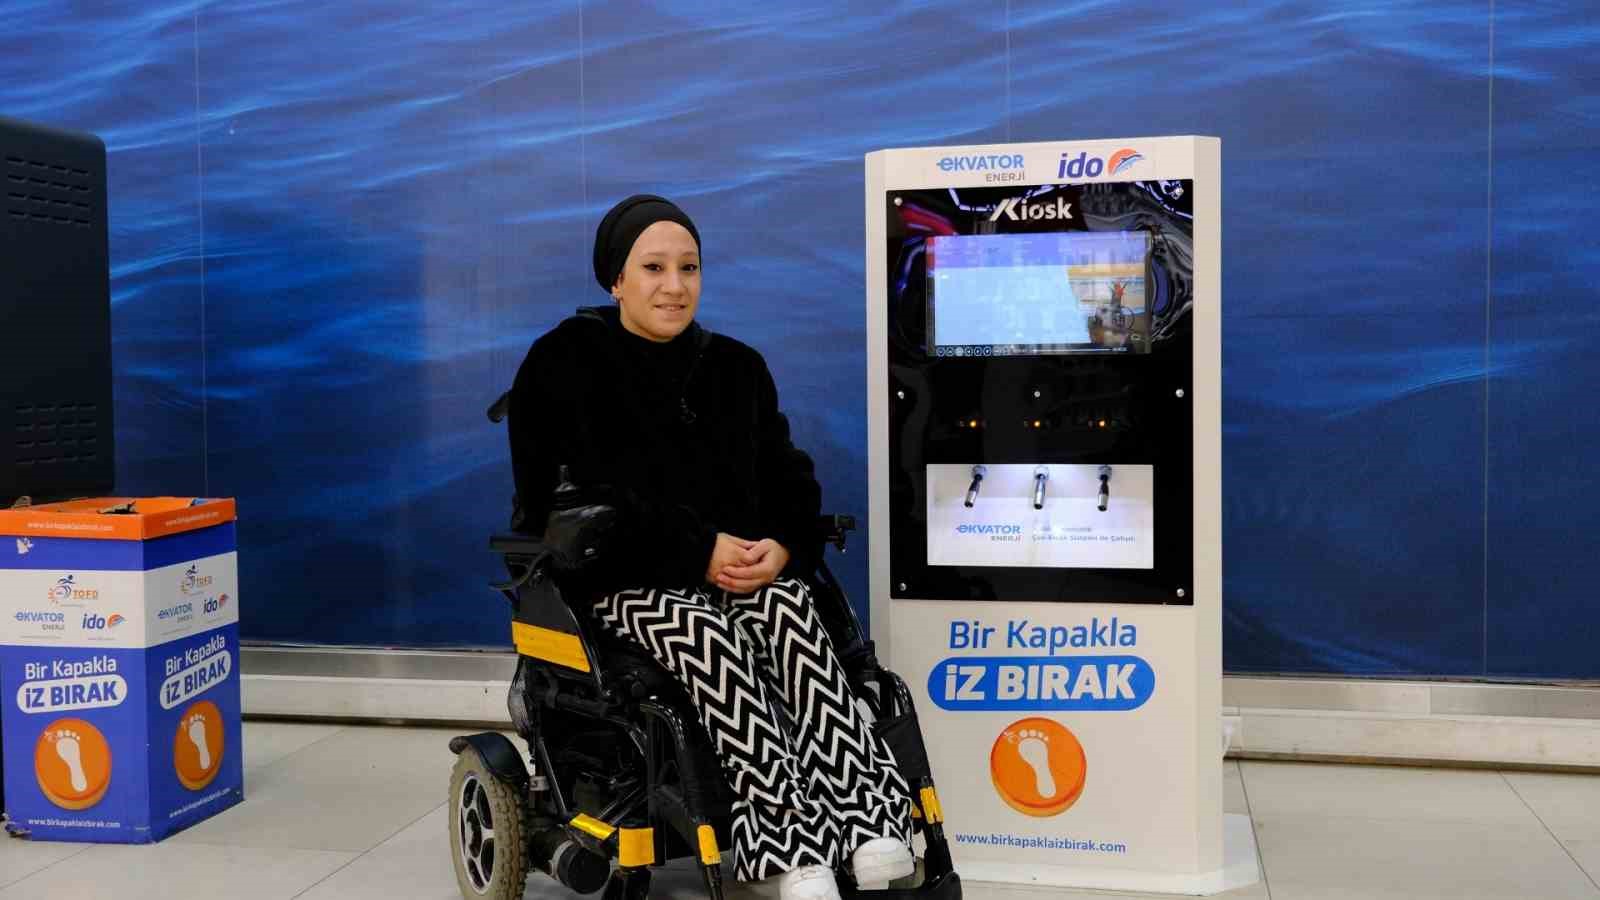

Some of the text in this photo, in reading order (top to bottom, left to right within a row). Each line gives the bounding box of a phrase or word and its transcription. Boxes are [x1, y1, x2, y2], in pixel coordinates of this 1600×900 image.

[1058, 152, 1103, 178] ido
[990, 197, 1073, 221] Kiosk
[203, 597, 218, 615] ido
[82, 613, 106, 629] ido
[950, 617, 1137, 656] Bir Kapakla
[25, 655, 117, 680] Bir Kapakla
[166, 634, 225, 676] Bir Kapakla
[184, 656, 226, 695] BIRAK
[996, 663, 1136, 700] BIRAK
[50, 681, 118, 706] BIRAK
[955, 832, 1126, 853] www.birkapaklaizbirak.com
